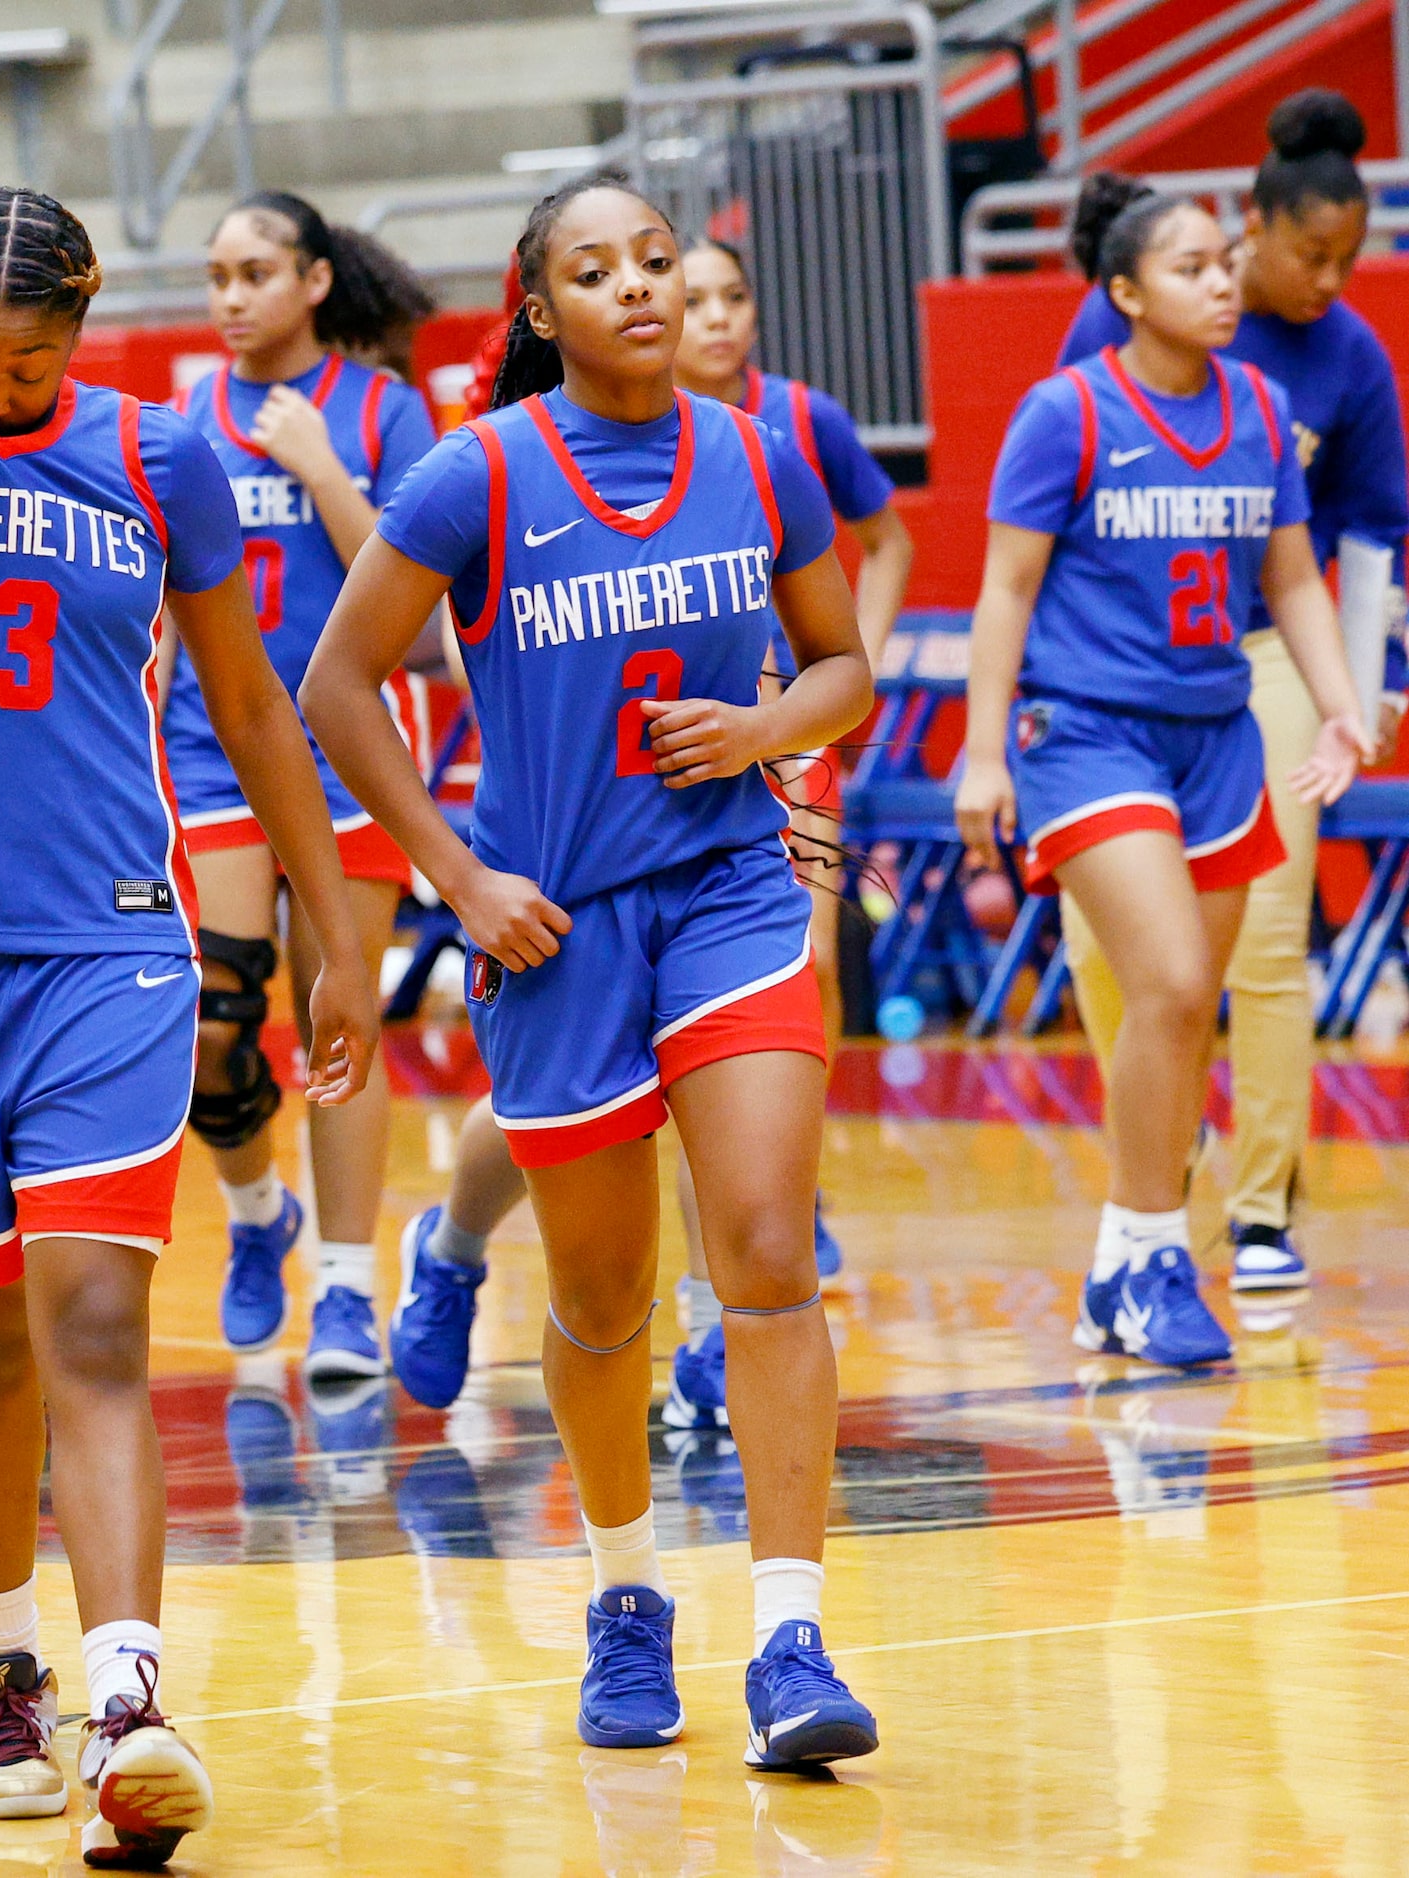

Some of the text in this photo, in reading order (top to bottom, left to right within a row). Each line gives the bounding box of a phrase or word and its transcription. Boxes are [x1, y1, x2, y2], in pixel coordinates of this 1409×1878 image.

[510, 545, 769, 652] PANTHERETTES
[1170, 548, 1233, 647] 21
[616, 648, 684, 777] 2
[158, 889, 168, 903] M
